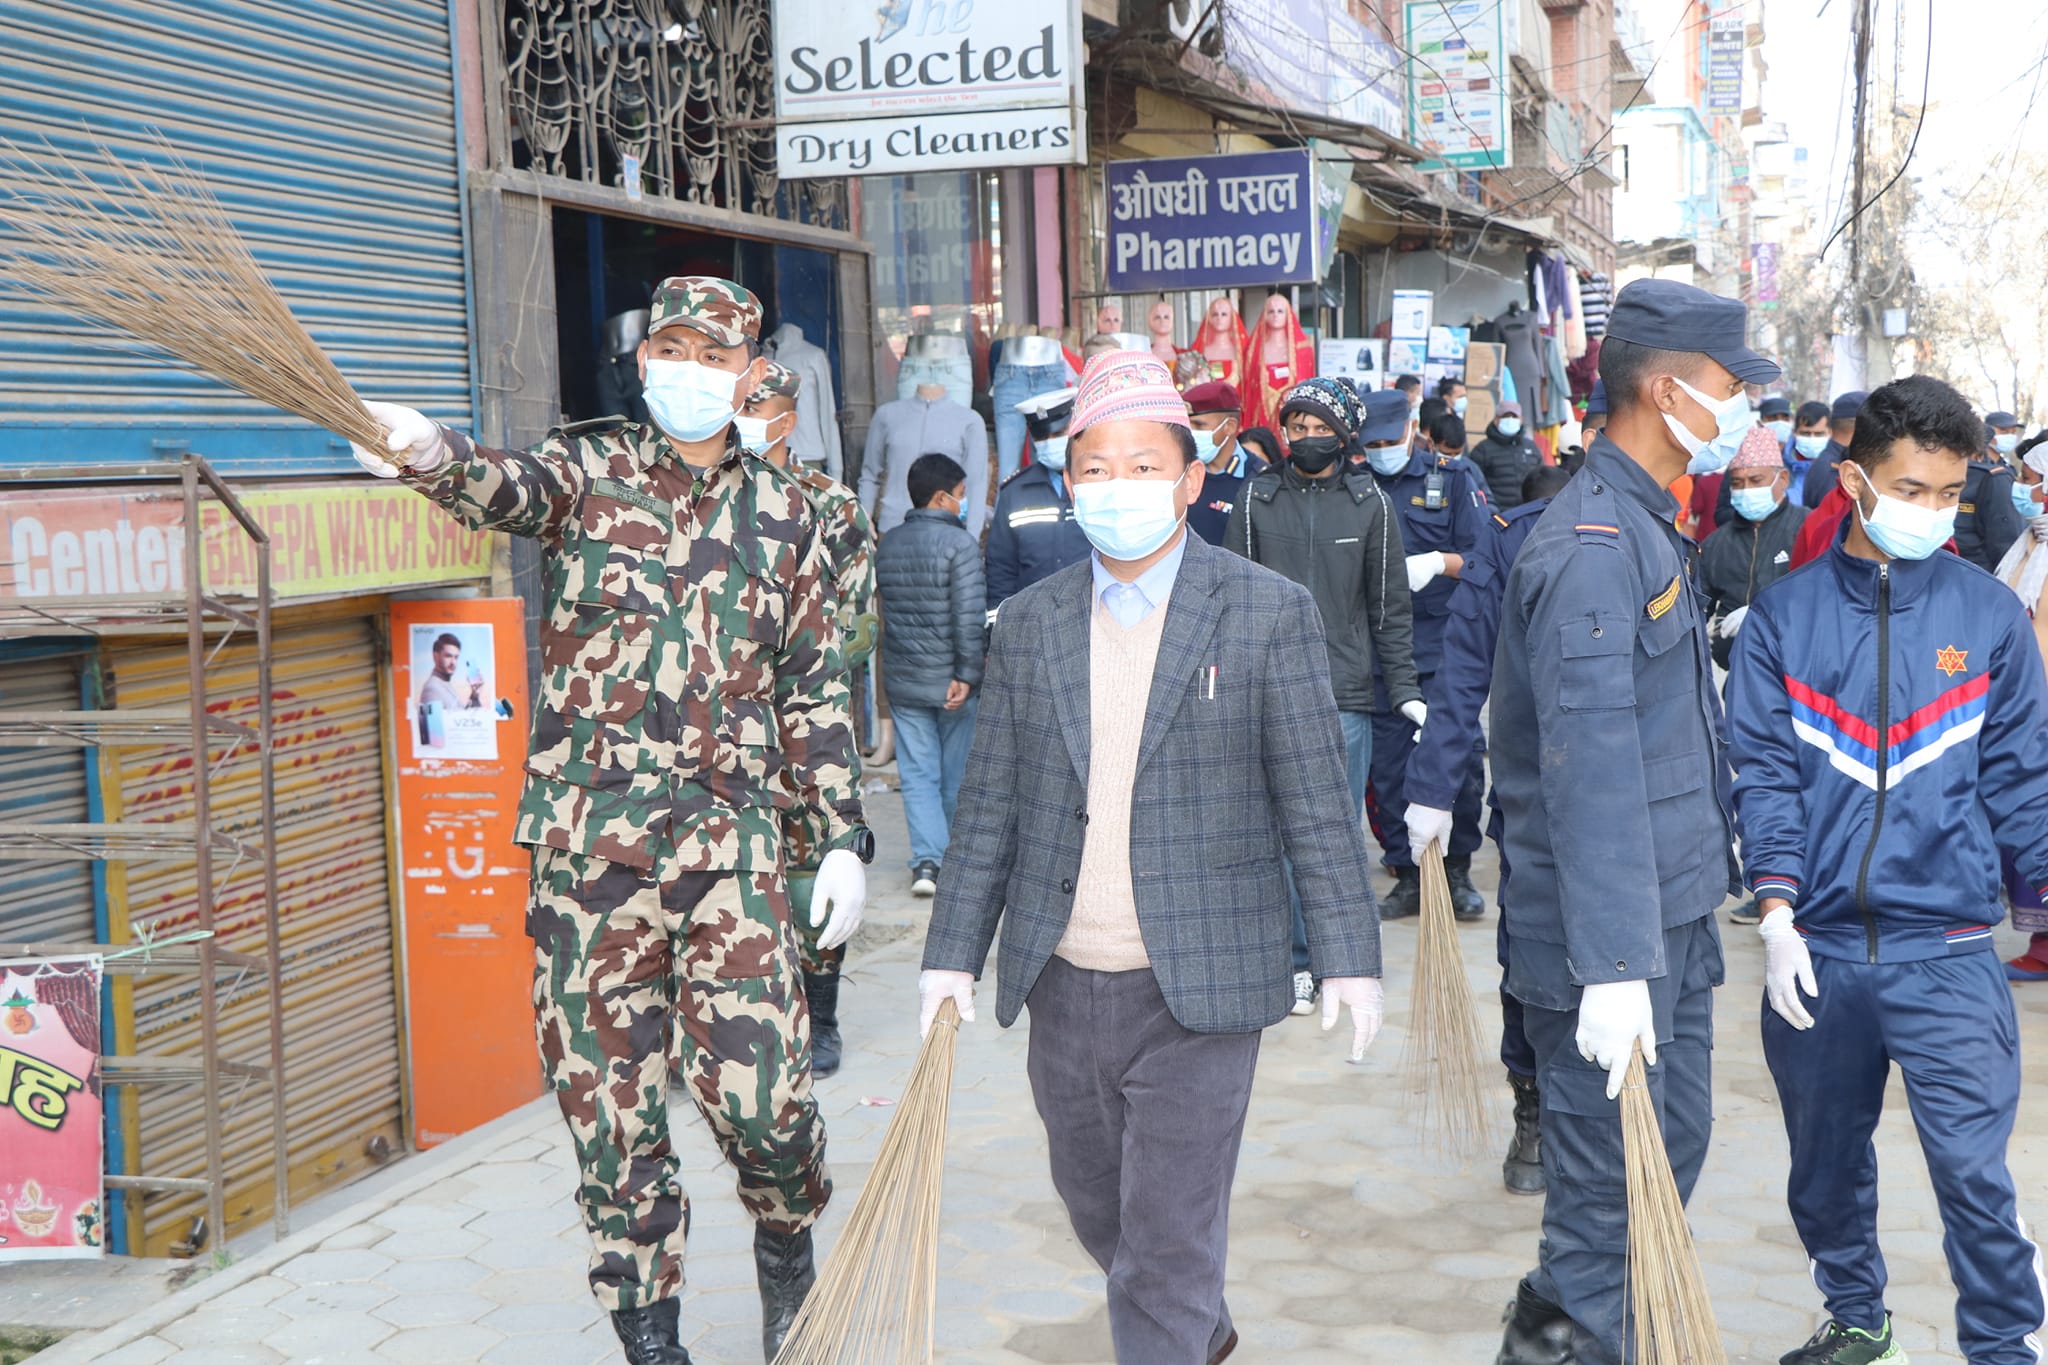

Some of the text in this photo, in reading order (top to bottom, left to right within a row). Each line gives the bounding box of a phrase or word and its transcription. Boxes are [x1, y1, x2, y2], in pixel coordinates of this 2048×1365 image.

[784, 24, 1062, 94] Selected
[788, 125, 1070, 169] Dry Cleaners
[1112, 167, 1208, 221] औषधी
[1217, 173, 1299, 215] पसल
[1116, 231, 1301, 273] Pharmacy
[12, 516, 186, 597] Center
[202, 502, 322, 585] BANEPA
[326, 498, 418, 577] WATCH
